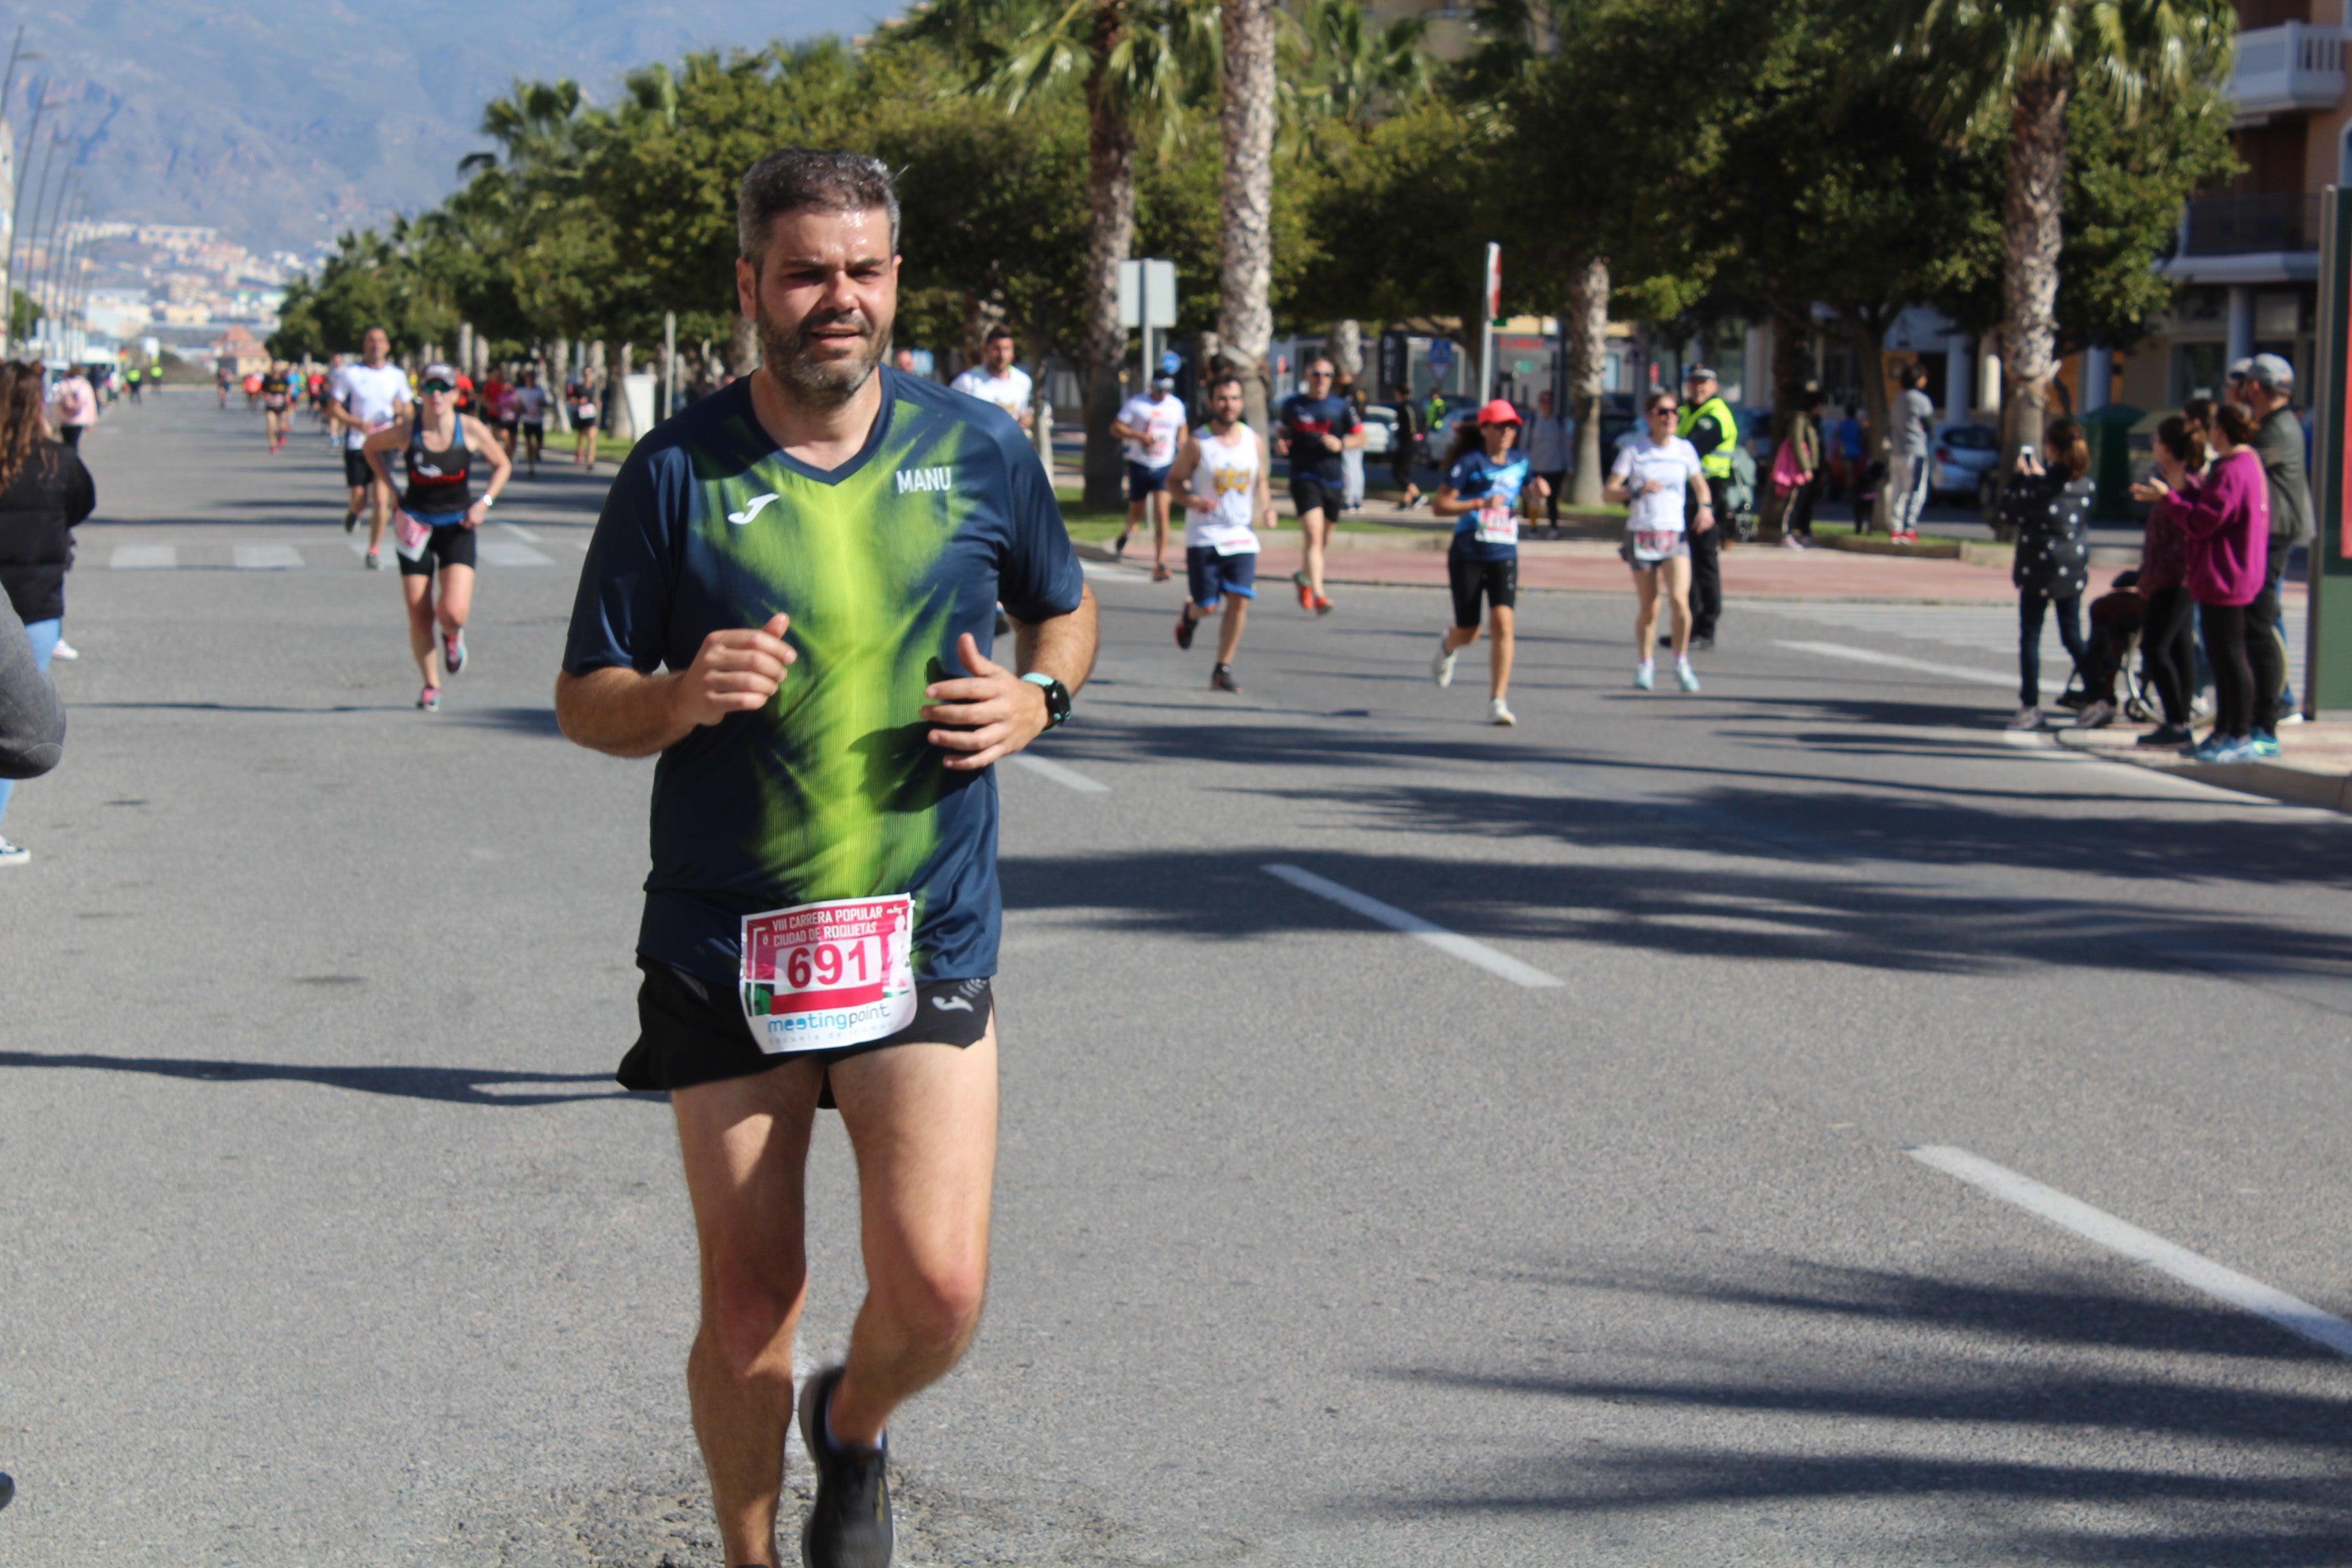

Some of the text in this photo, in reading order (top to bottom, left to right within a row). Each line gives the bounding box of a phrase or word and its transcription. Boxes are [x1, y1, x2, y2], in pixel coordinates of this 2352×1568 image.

[896, 466, 951, 493] MANU
[772, 906, 883, 932] VIII CARRERA POPULAR
[773, 921, 877, 947] CIUDAD DE ROQUETAS
[788, 940, 867, 989] 691
[767, 1004, 891, 1033] meetingpoint
